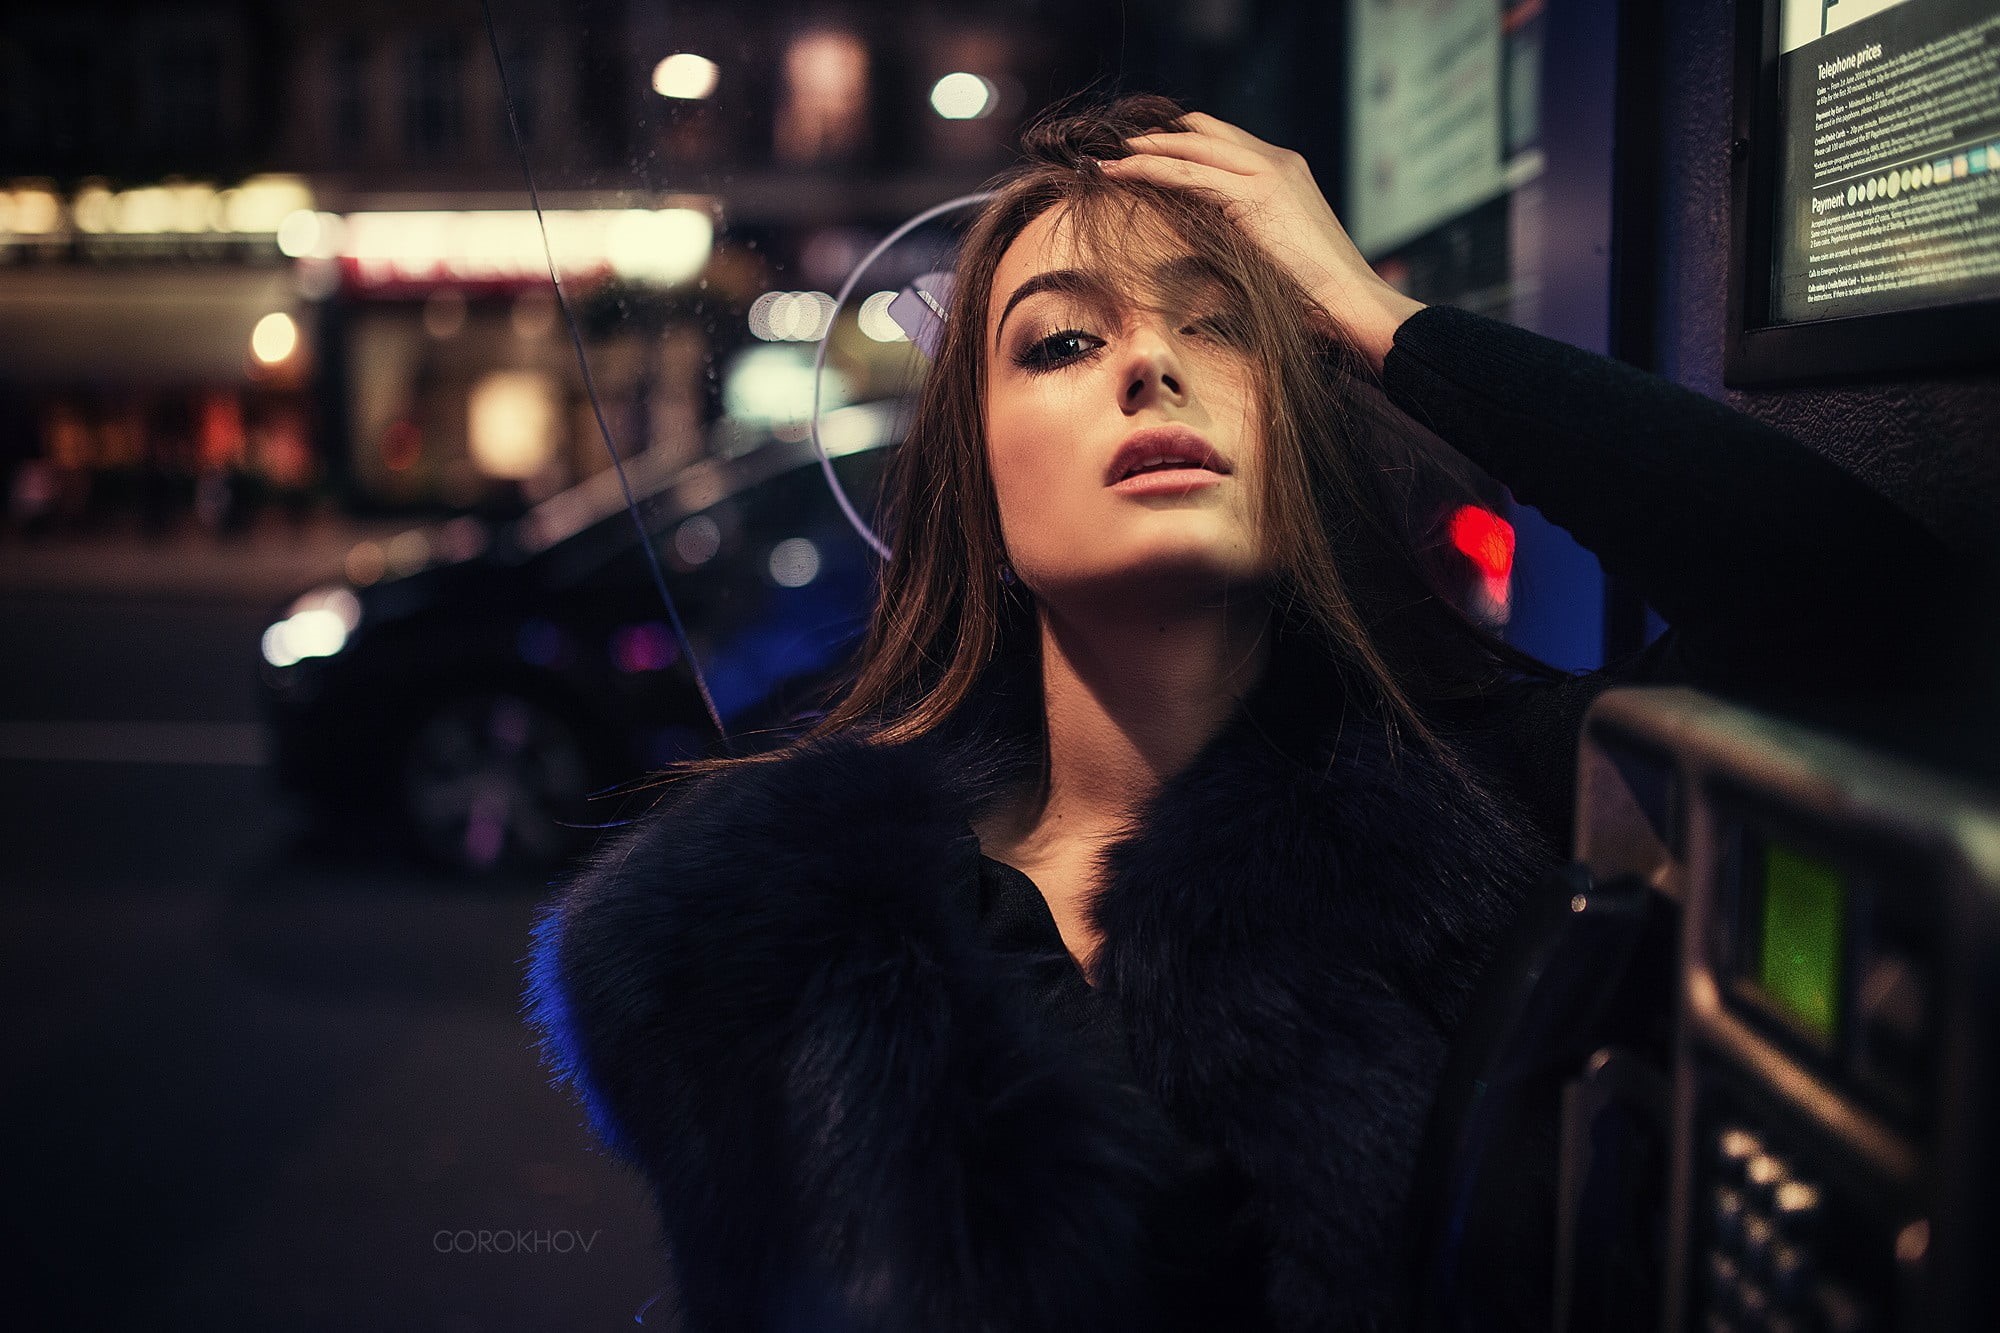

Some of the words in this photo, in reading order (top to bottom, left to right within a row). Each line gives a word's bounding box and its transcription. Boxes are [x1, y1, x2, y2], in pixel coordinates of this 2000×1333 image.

[1817, 54, 1856, 80] Telephone
[1857, 44, 1881, 67] prices
[1815, 122, 1823, 131] Euro
[1811, 191, 1844, 215] Payment
